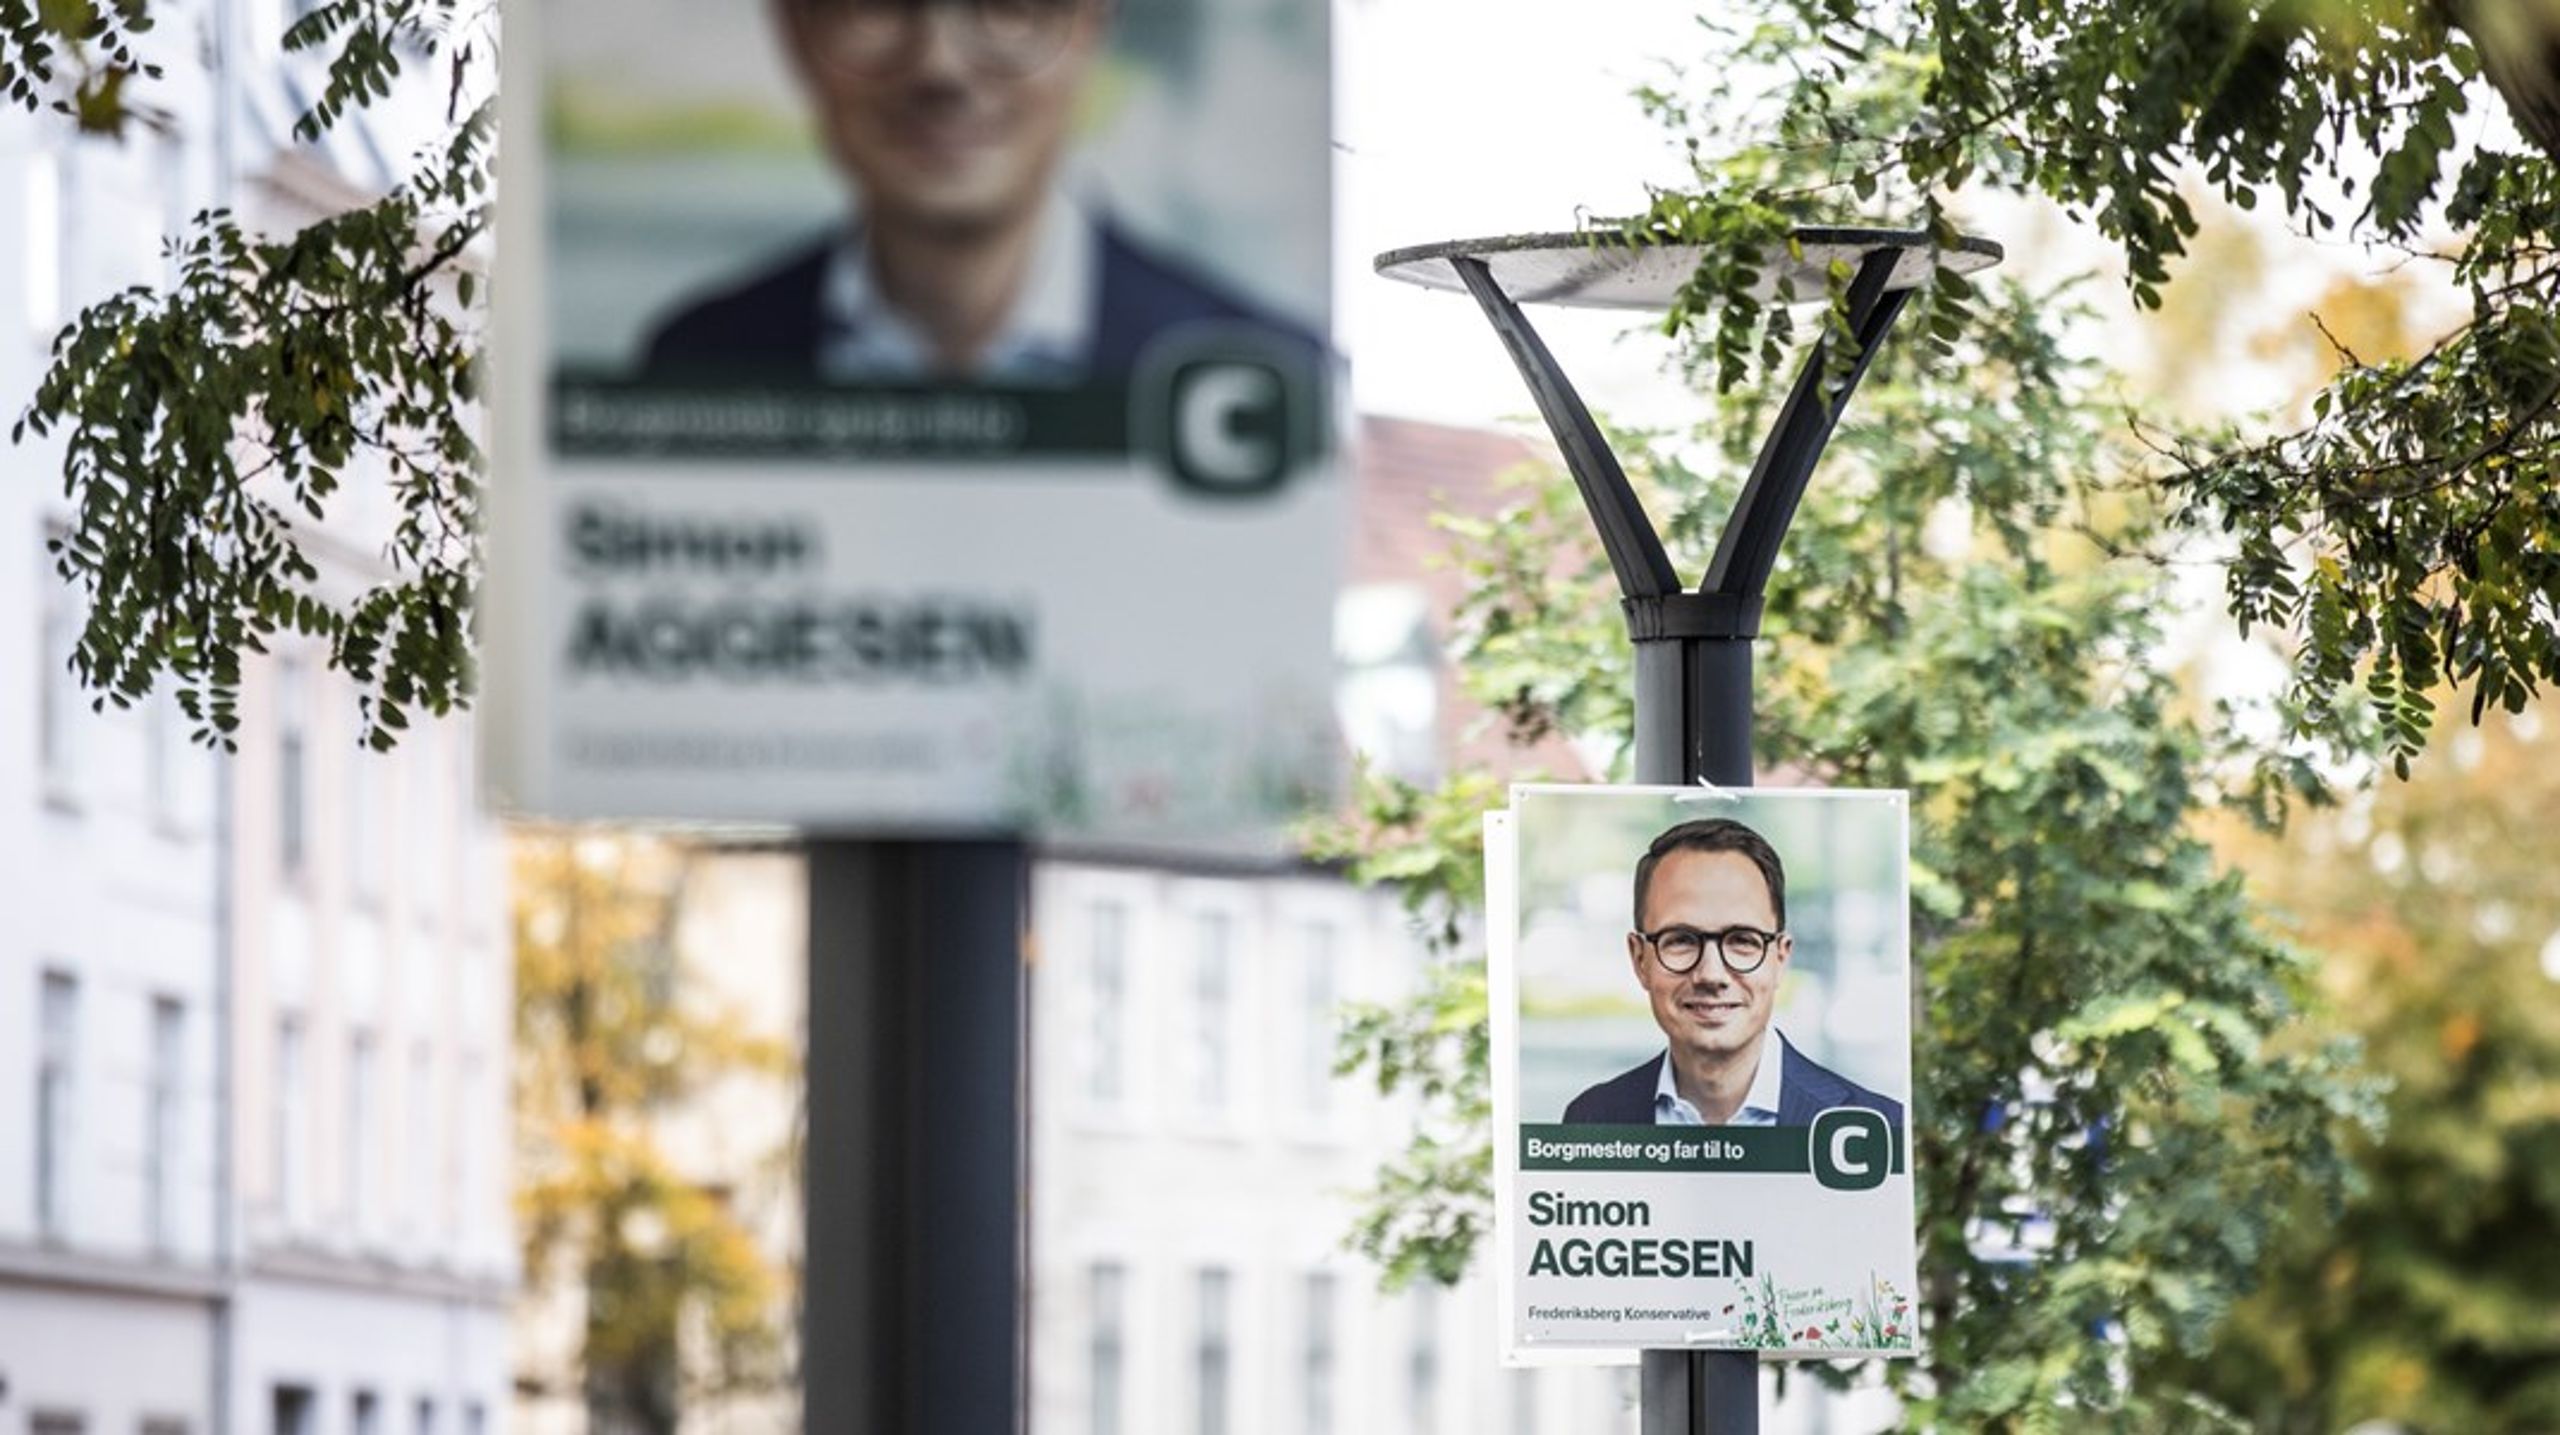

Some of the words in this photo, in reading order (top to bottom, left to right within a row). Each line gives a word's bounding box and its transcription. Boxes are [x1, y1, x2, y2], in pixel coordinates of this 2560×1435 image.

[1180, 364, 1282, 483] C
[566, 497, 814, 574] Simon
[567, 598, 1030, 680] AGGESEN
[1527, 1138, 1641, 1161] Borgmester
[1645, 1144, 1670, 1163] og
[1673, 1139, 1699, 1158] far
[1703, 1140, 1721, 1159] til
[1724, 1141, 1745, 1160] to
[1829, 1125, 1870, 1176] C
[1528, 1191, 1650, 1226] Simon
[1528, 1238, 1754, 1278] AGGESEN
[1528, 1305, 1621, 1322] Frederiksberg
[1624, 1307, 1711, 1321] Konservative
